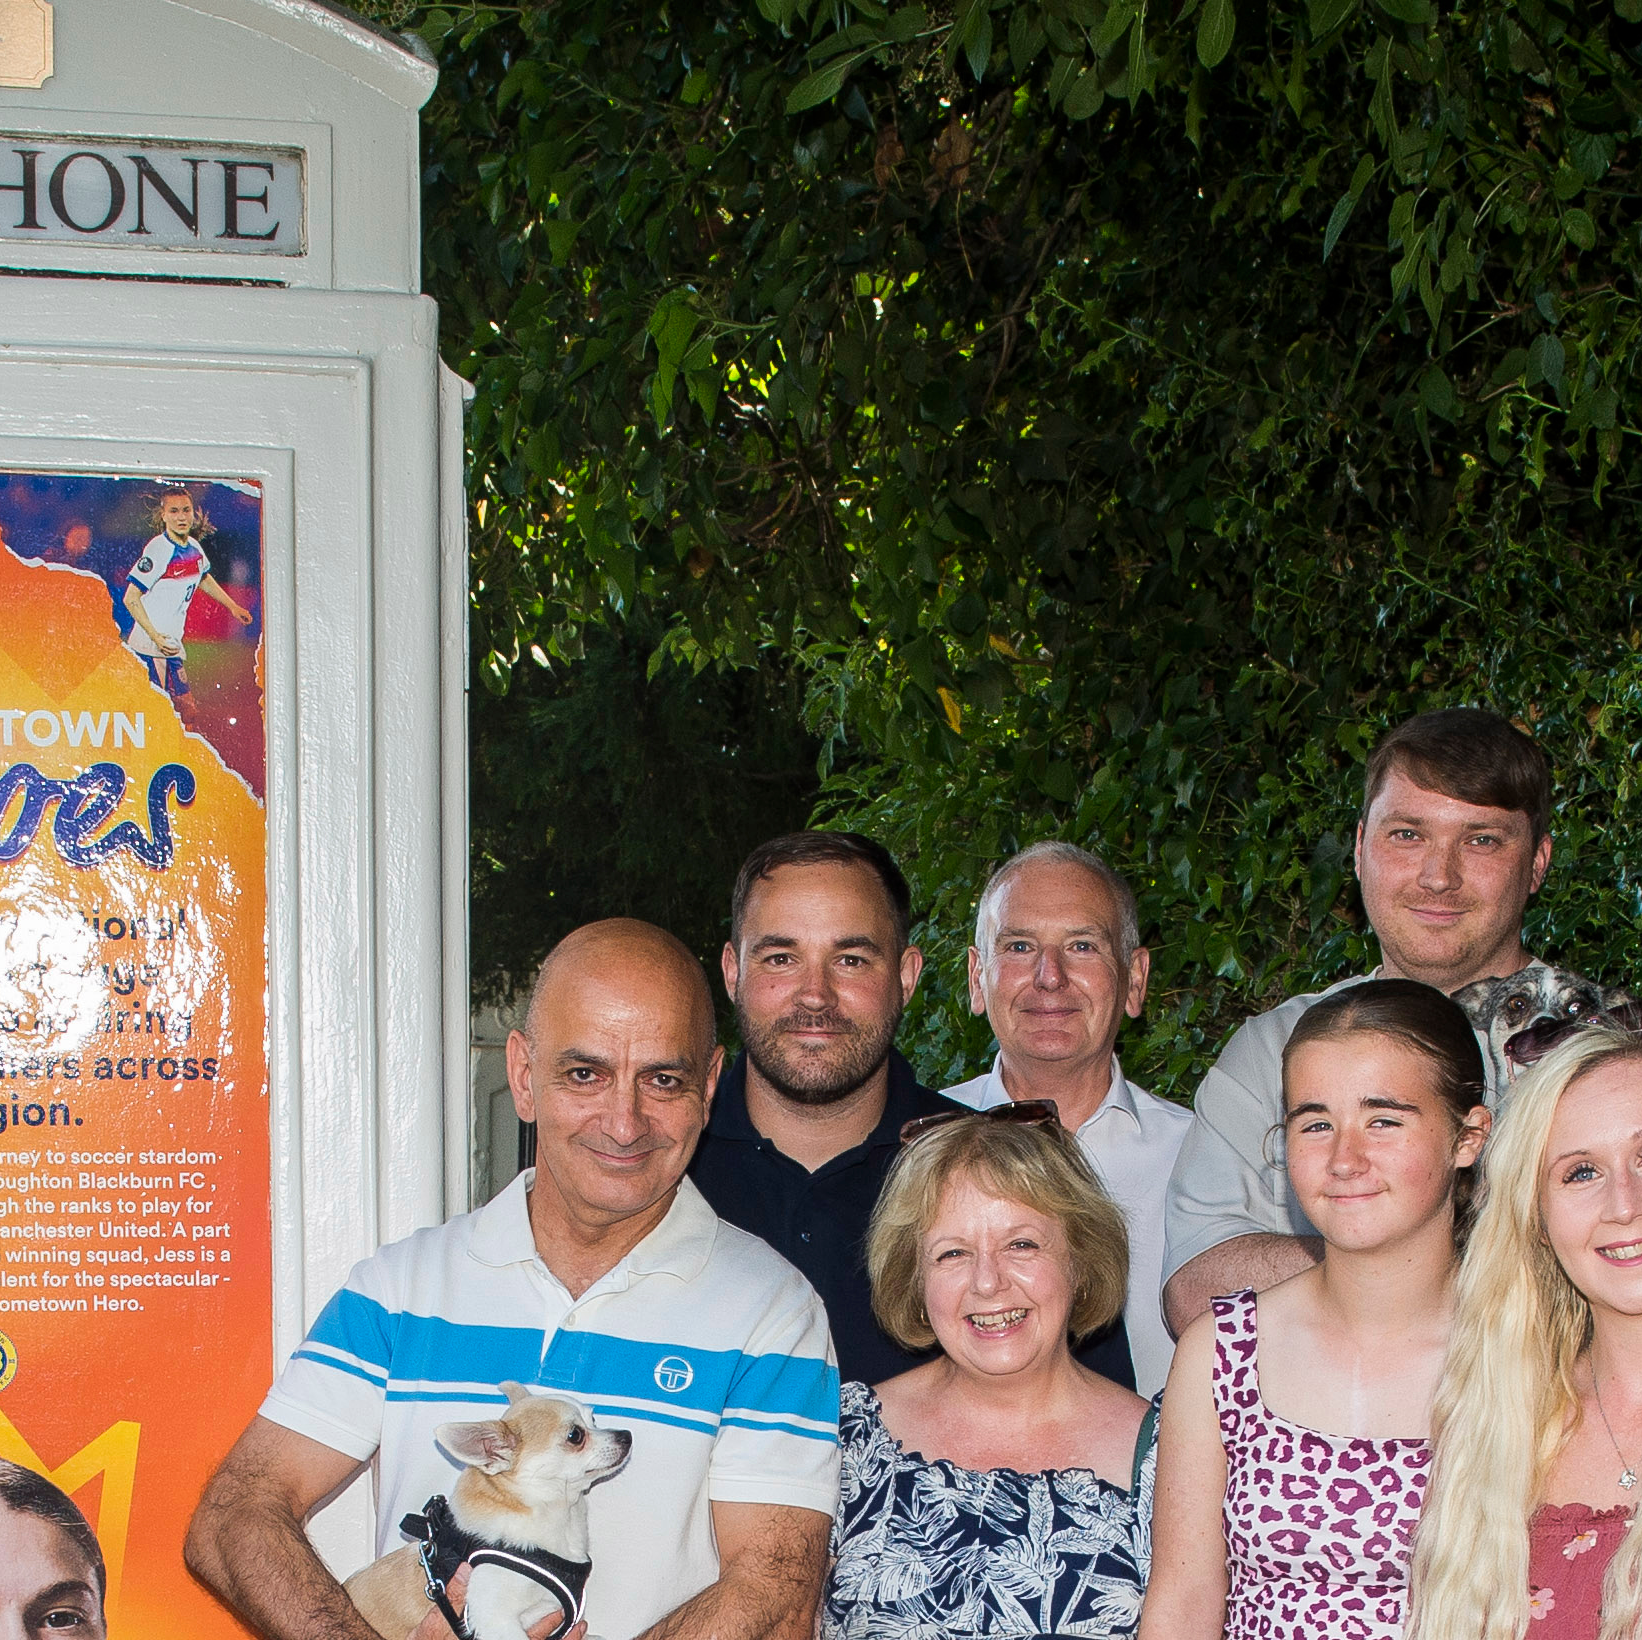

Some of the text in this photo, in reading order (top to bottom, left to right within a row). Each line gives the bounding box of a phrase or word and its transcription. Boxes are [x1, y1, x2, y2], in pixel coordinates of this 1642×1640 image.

[94, 1056, 219, 1080] across
[45, 1149, 66, 1165] to
[70, 1151, 134, 1165] soccer
[138, 1147, 216, 1165] stardom
[78, 1171, 173, 1190] Blackburn
[179, 1171, 206, 1189] FC
[23, 1196, 56, 1214] the
[60, 1196, 112, 1214] ranks
[116, 1198, 137, 1214] to
[142, 1196, 182, 1217] play
[185, 1196, 214, 1214] for
[99, 1220, 167, 1239] United.
[171, 1221, 187, 1238] A
[192, 1222, 231, 1242] part
[4, 1245, 81, 1267] winning
[86, 1245, 149, 1267] squad,
[153, 1245, 196, 1263] Jess
[200, 1245, 216, 1263] is
[220, 1250, 231, 1263] a
[41, 1270, 70, 1288] for
[73, 1269, 105, 1287] the
[109, 1269, 220, 1291] spectacular
[93, 1294, 145, 1312] Hero.
